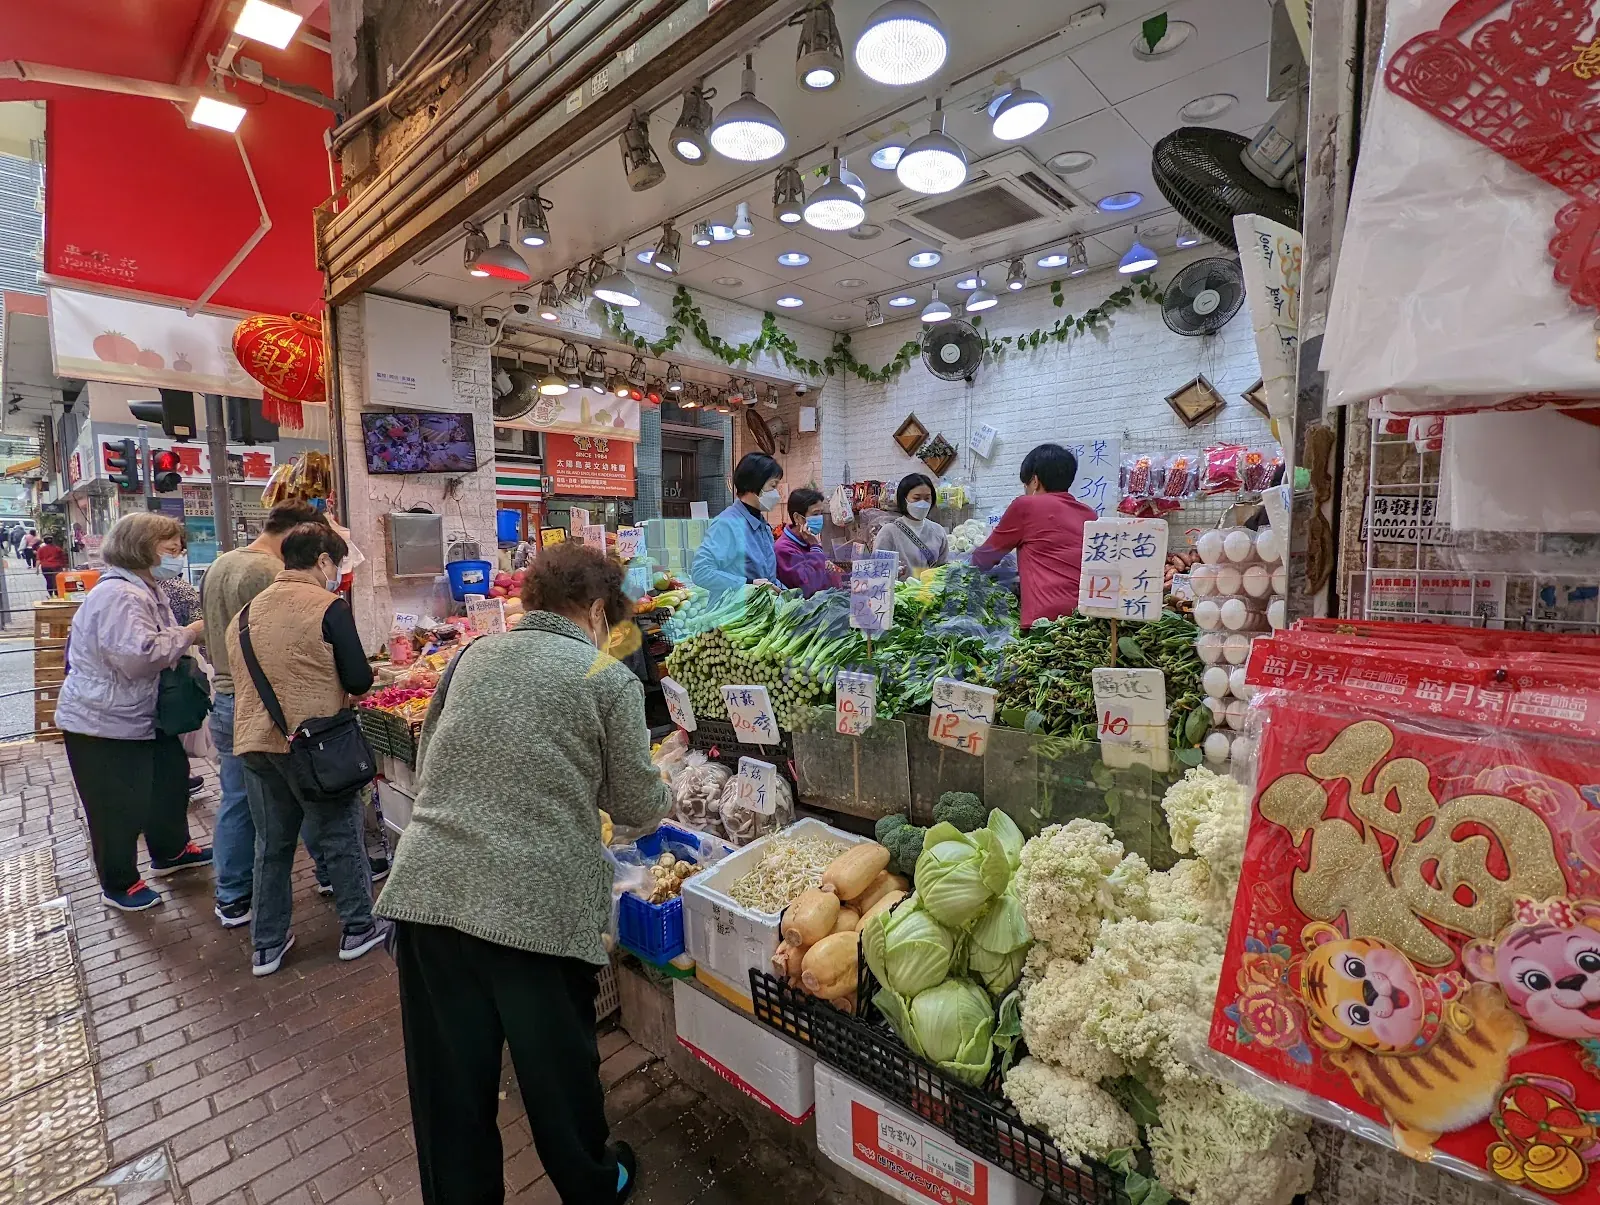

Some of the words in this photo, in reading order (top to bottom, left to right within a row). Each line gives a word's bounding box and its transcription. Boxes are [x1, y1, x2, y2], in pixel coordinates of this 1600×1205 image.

[556, 459, 626, 472] 太陽島英文幼稚園
[1088, 574, 1113, 600] 12
[1262, 654, 1342, 684] 蓝月亮
[1414, 677, 1509, 712] 蓝月亮
[1100, 710, 1129, 736] 10
[1258, 720, 1568, 967] 福
